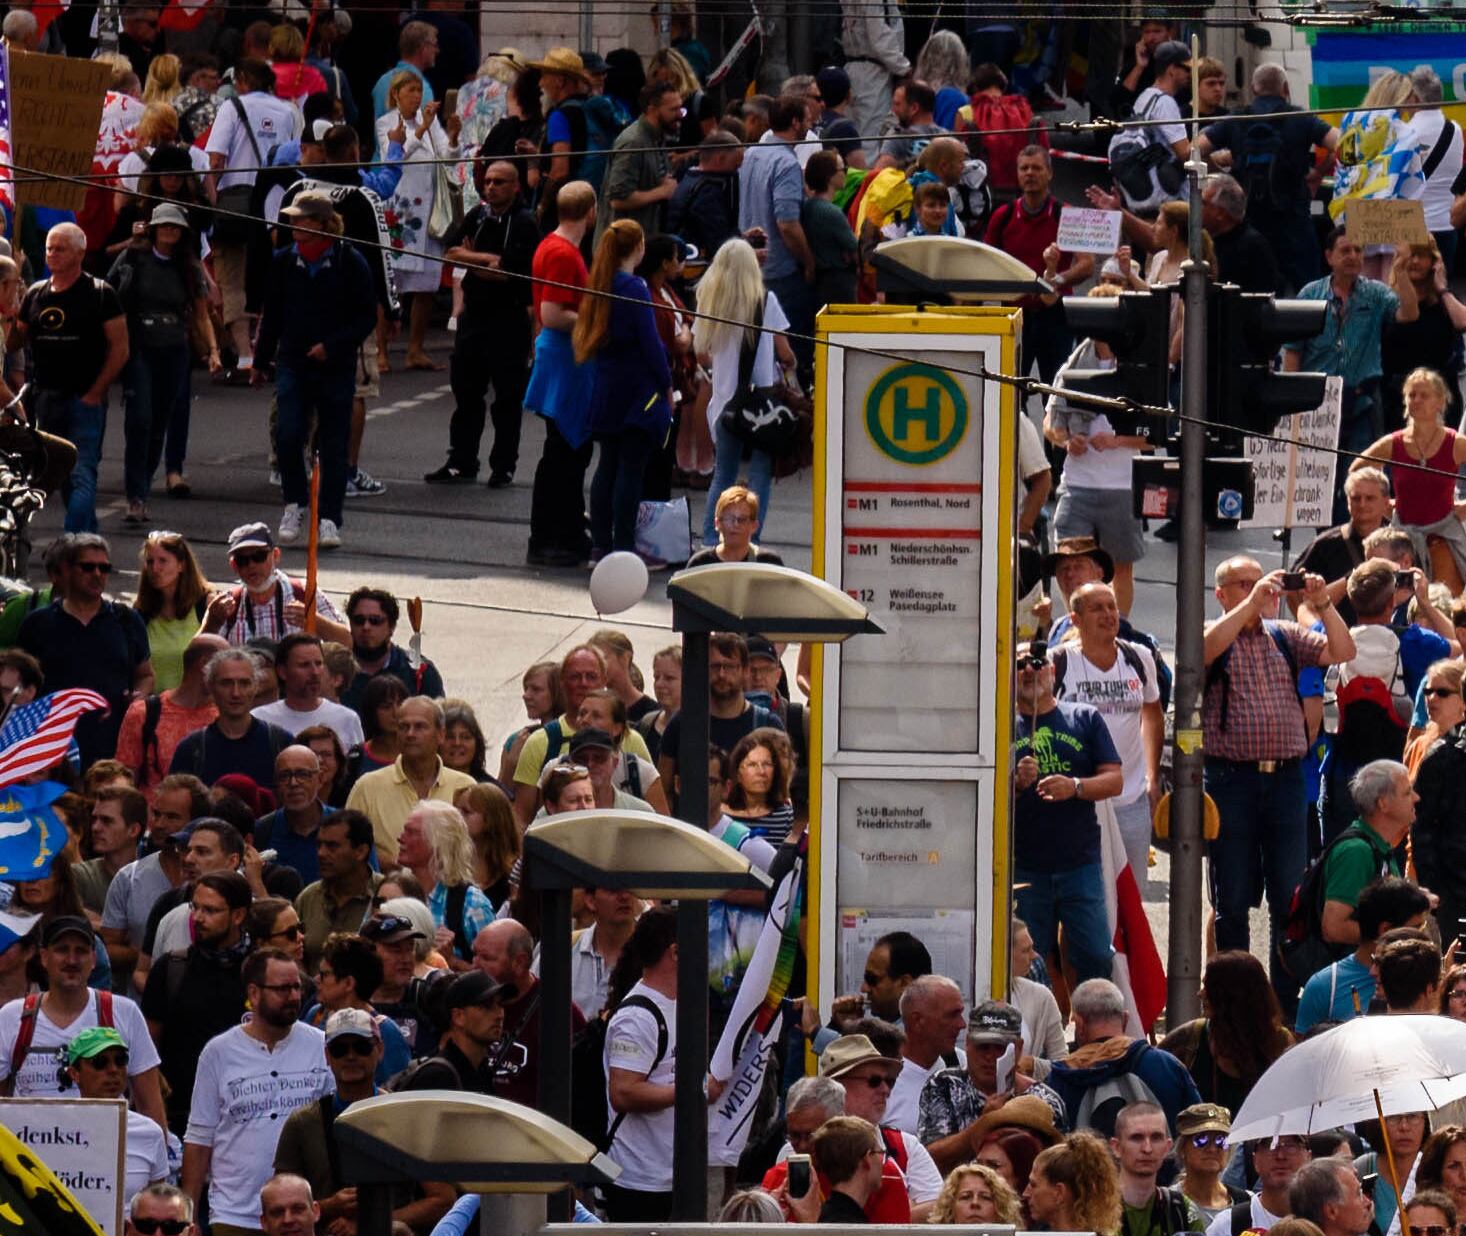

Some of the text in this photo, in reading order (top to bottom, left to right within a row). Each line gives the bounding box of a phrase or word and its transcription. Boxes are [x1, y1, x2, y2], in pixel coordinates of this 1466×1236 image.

[892, 386, 941, 442] H
[1254, 458, 1330, 481] ofortige ufhebung
[858, 498, 879, 511] M1
[945, 498, 970, 510] Nord
[858, 543, 879, 556] M1
[860, 589, 874, 602] 12
[889, 601, 957, 613] Pasedagplatz
[856, 806, 924, 818] S+U-Bahnhof
[856, 818, 932, 830] Friedrichstraße
[860, 851, 918, 863] Tarifbereich
[17, 1126, 89, 1148] denkst,
